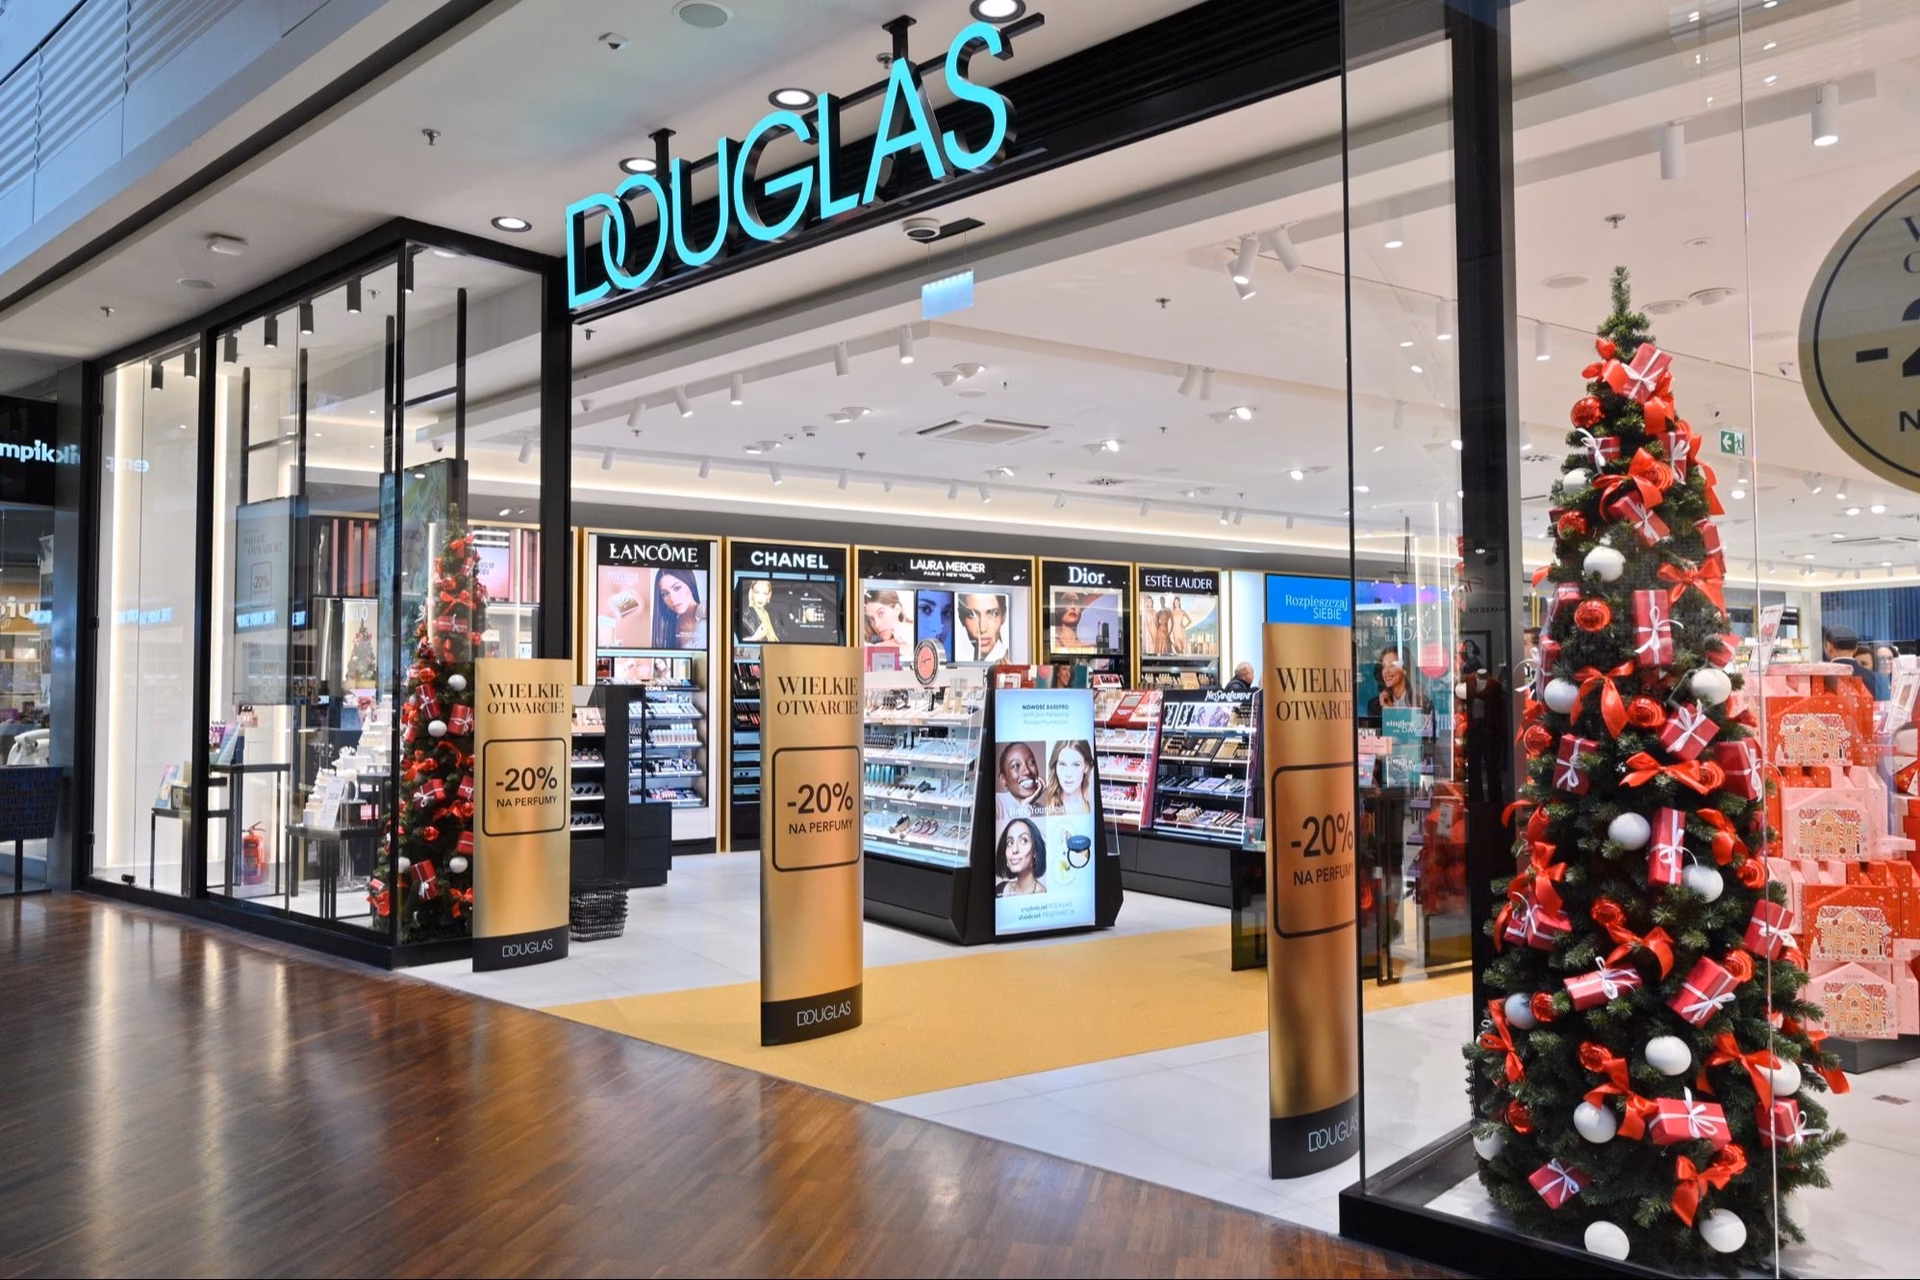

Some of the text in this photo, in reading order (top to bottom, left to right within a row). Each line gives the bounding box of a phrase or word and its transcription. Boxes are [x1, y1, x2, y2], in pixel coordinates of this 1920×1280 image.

[566, 22, 1009, 309] DOUGLAS
[609, 543, 698, 563] LANCÔME
[751, 551, 829, 569] CHANEL
[910, 559, 985, 573] LAURA MERCIER
[1068, 566, 1105, 585] Dior
[1175, 578, 1213, 589] LAUDER
[1285, 594, 1348, 611] Rozpieszczaj
[1313, 607, 1342, 620] SIEBIE
[488, 683, 564, 698] WIELKIE
[777, 676, 858, 696] WIELKIE
[487, 701, 565, 714] OTWARCIE!
[776, 700, 858, 716] OTWARCIE!
[496, 766, 558, 792] -20%
[496, 795, 558, 808] NA PERFUMY
[787, 781, 853, 814] -20%
[788, 818, 854, 835] NA PERFUMY
[1290, 811, 1354, 858] -20%
[1293, 871, 1313, 886] NA
[502, 938, 553, 958] DOUGLAS
[796, 1000, 851, 1027] DOUGLAS
